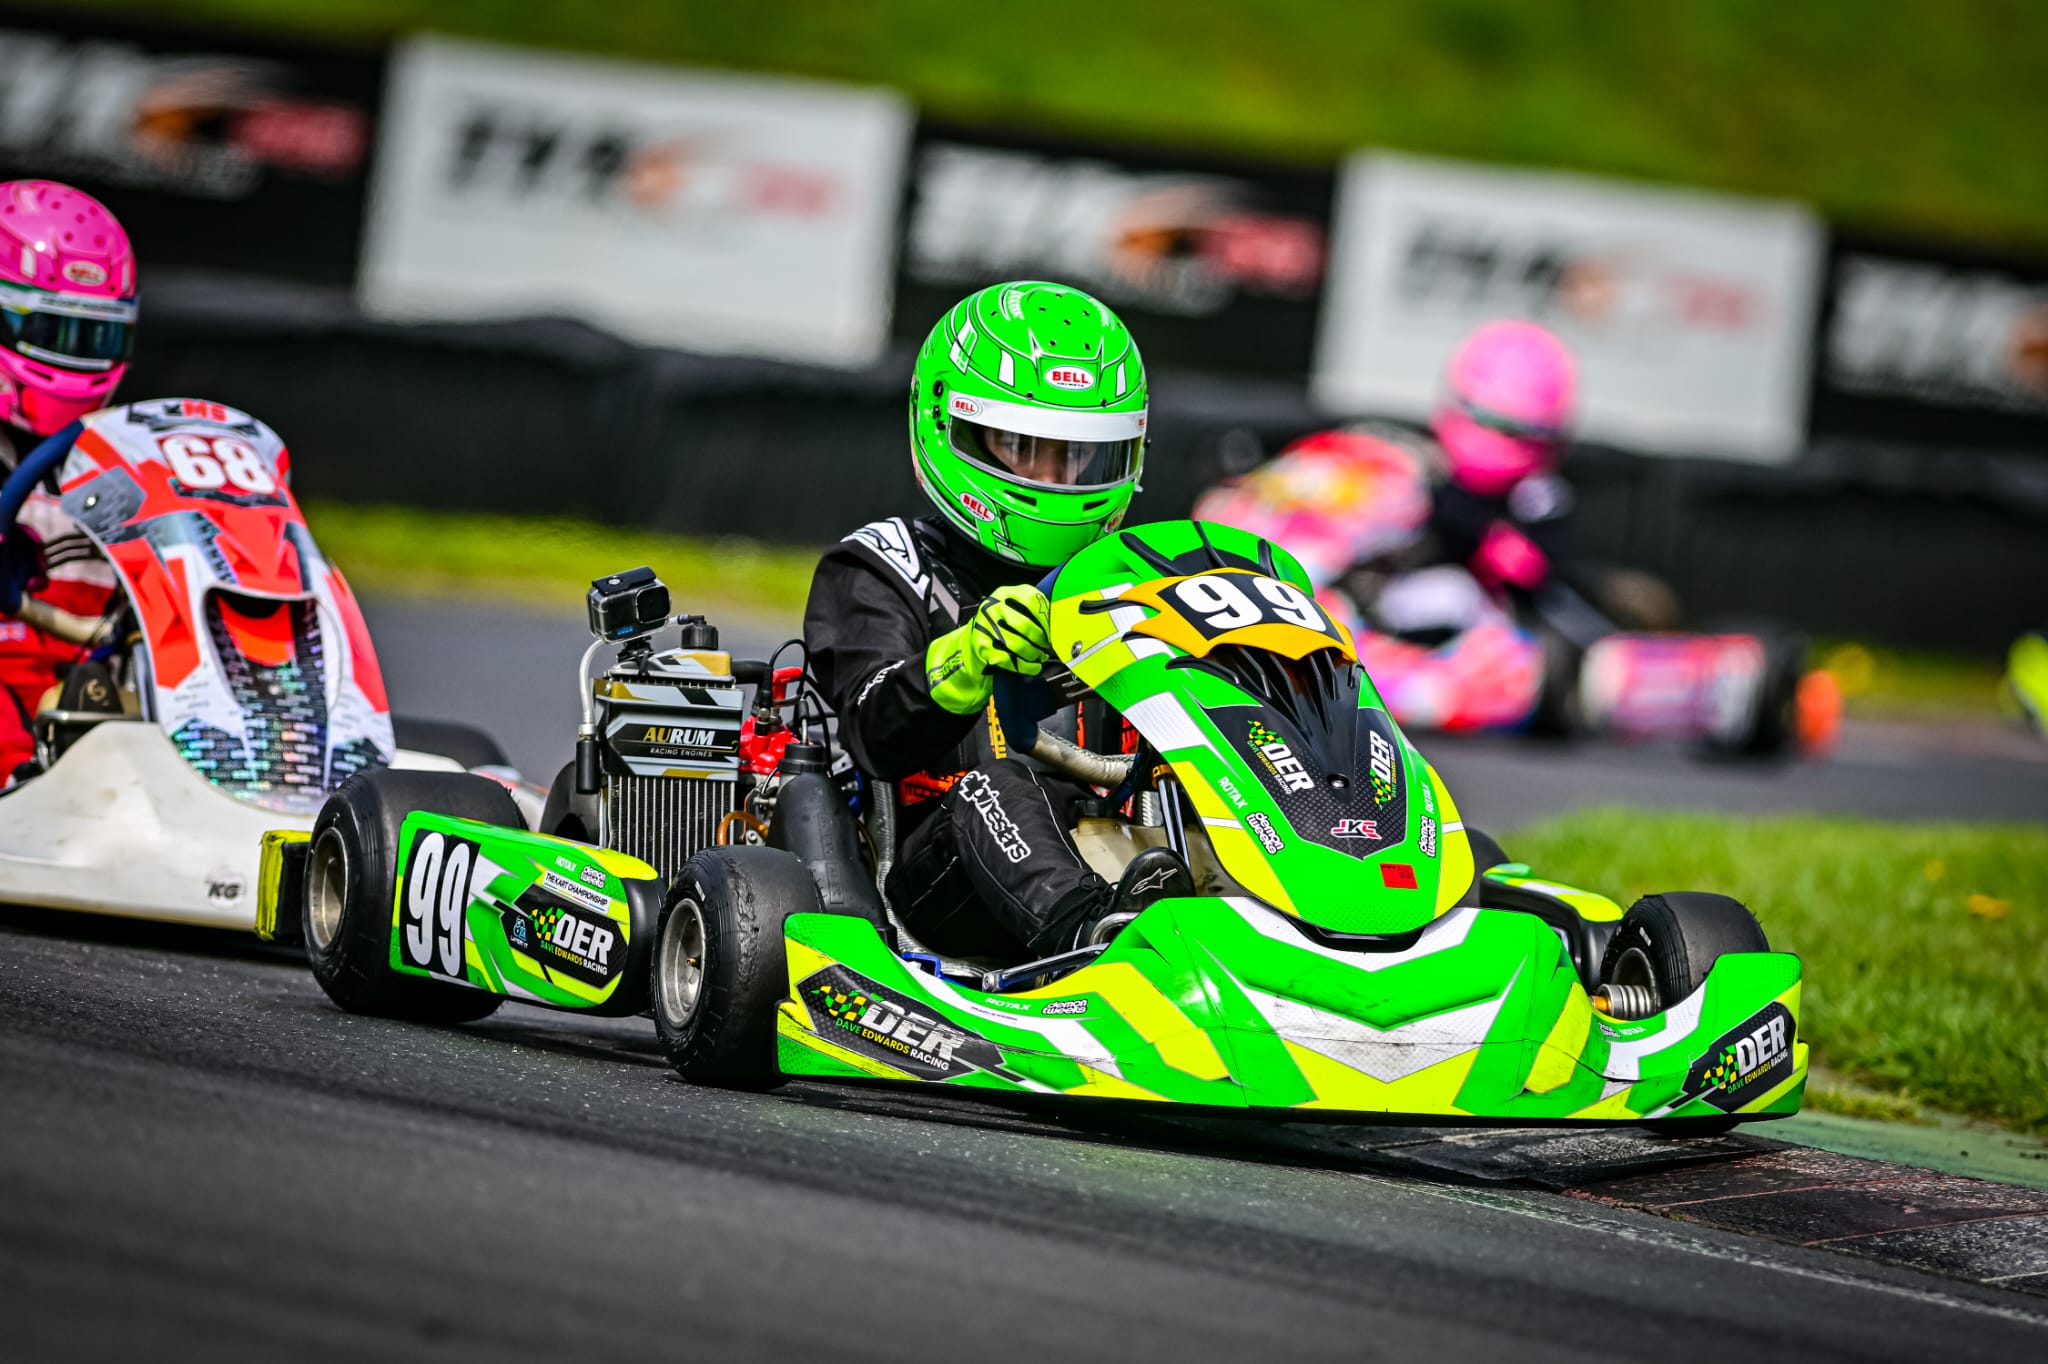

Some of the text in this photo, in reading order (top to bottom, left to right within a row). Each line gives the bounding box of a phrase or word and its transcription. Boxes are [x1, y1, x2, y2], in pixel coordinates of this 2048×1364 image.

[1052, 370, 1090, 384] BELL
[955, 400, 976, 413] BELL
[163, 435, 275, 494] 68
[963, 494, 990, 519] BELL
[1175, 575, 1327, 632] 99
[643, 726, 716, 746] AURUM
[650, 747, 713, 758] RACING ENGINES
[1260, 743, 1315, 793] DER
[1370, 730, 1391, 785] DER
[1217, 776, 1248, 809] ROTAX
[1256, 812, 1284, 850] demon
[406, 832, 470, 976] 99
[552, 913, 614, 964] DER
[554, 947, 583, 966] EDWARDS
[582, 958, 608, 976] RACING
[985, 997, 1031, 1011] ROTAX
[836, 1017, 950, 1071] DAVE EDWARDS RACING
[859, 1000, 965, 1061] DER
[1735, 1014, 1786, 1078] DER
[1727, 1078, 1744, 1095] DAVE
[1744, 1061, 1771, 1084] EDWARDS
